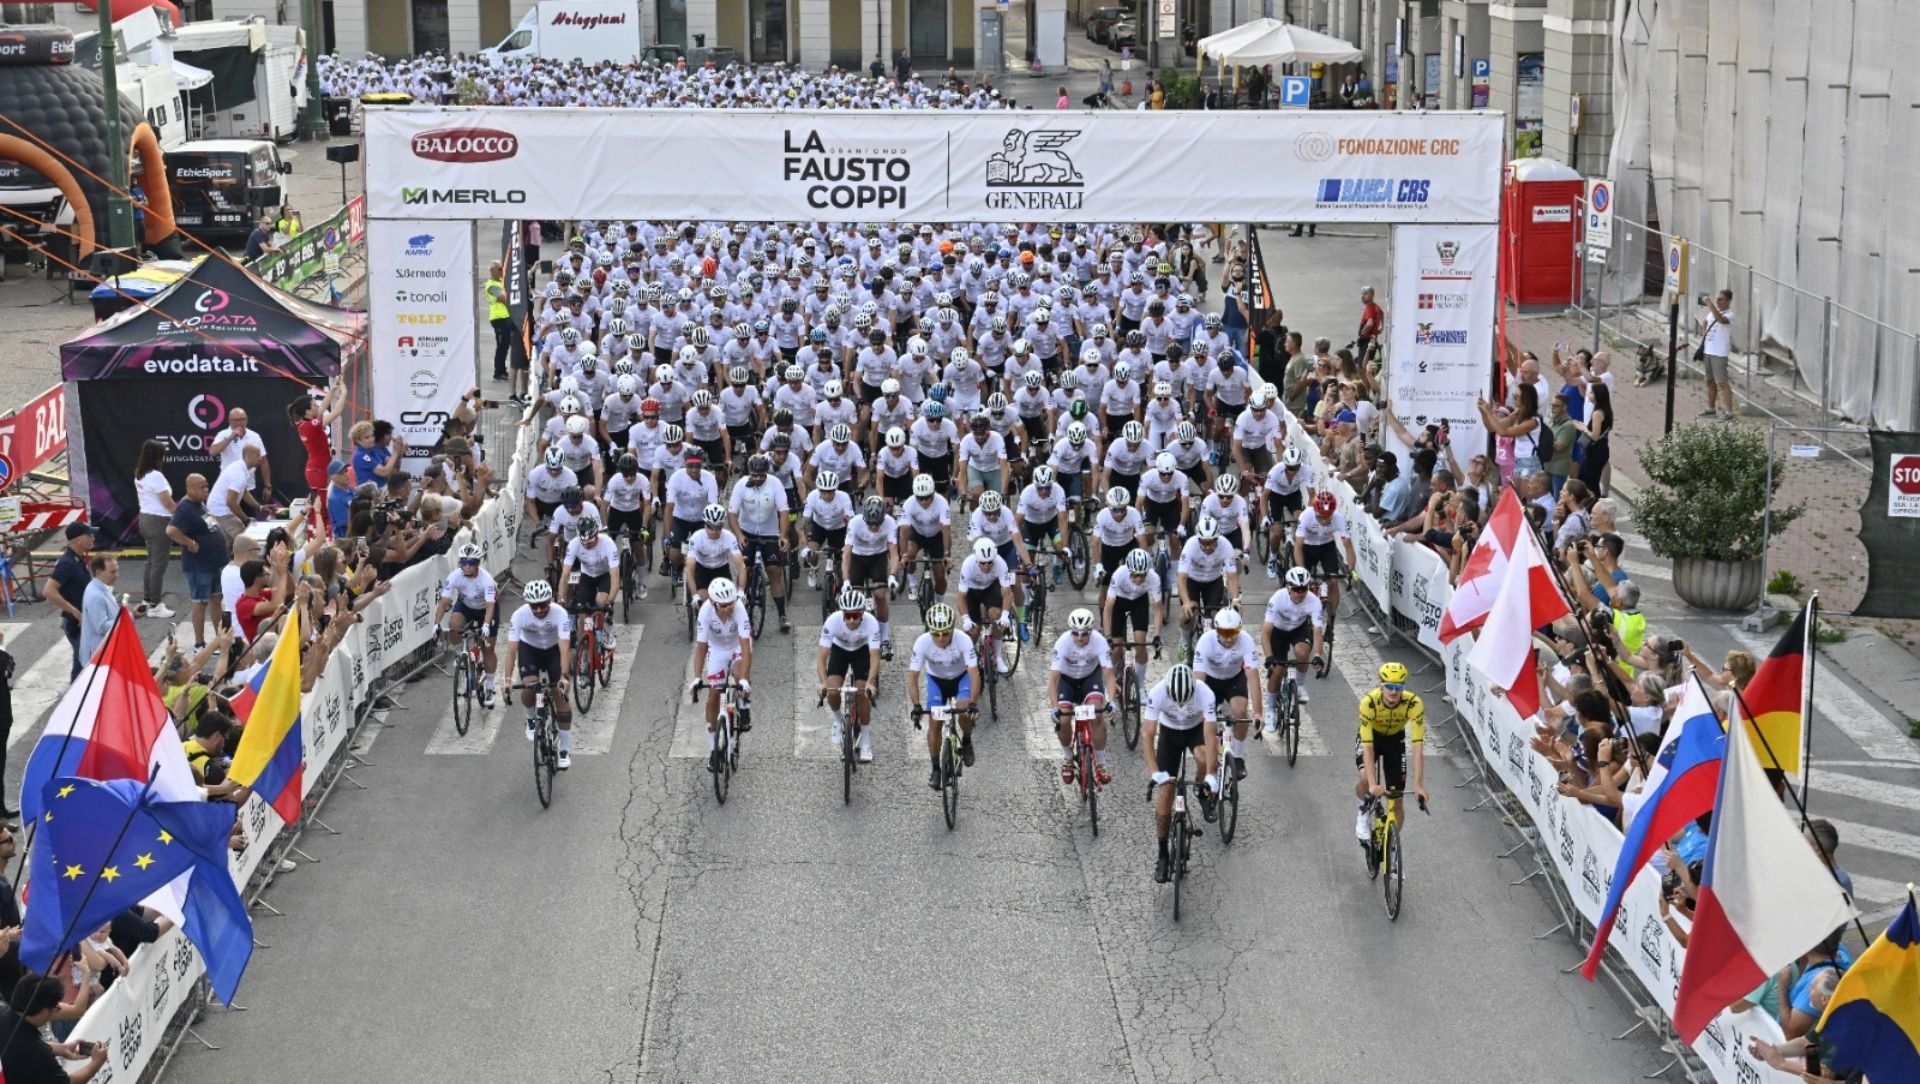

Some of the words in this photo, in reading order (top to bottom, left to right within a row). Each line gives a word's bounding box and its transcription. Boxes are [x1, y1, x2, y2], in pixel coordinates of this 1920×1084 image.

[551, 11, 626, 30] Noleggiami
[0, 44, 26, 55] ort
[1475, 60, 1488, 75] P
[1286, 79, 1304, 103] P
[414, 136, 514, 154] BALOCCO
[783, 129, 826, 153] LA
[829, 146, 908, 155] GRANFONDO
[1338, 138, 1427, 156] FONDAZIONE
[1430, 139, 1459, 156] CRC
[176, 167, 232, 179] EthicSport
[783, 157, 911, 182] FAUSTO
[432, 189, 526, 204] MERLO
[806, 185, 907, 210] COPPI
[1340, 178, 1395, 203] BANCA
[1396, 179, 1431, 203] CRS
[985, 191, 1085, 210] GENERALI
[410, 290, 448, 303] tonoli
[156, 313, 258, 332] EVODATA
[143, 353, 259, 373] evodata.it
[155, 434, 217, 451] EVOD
[119, 1014, 130, 1040] LA
